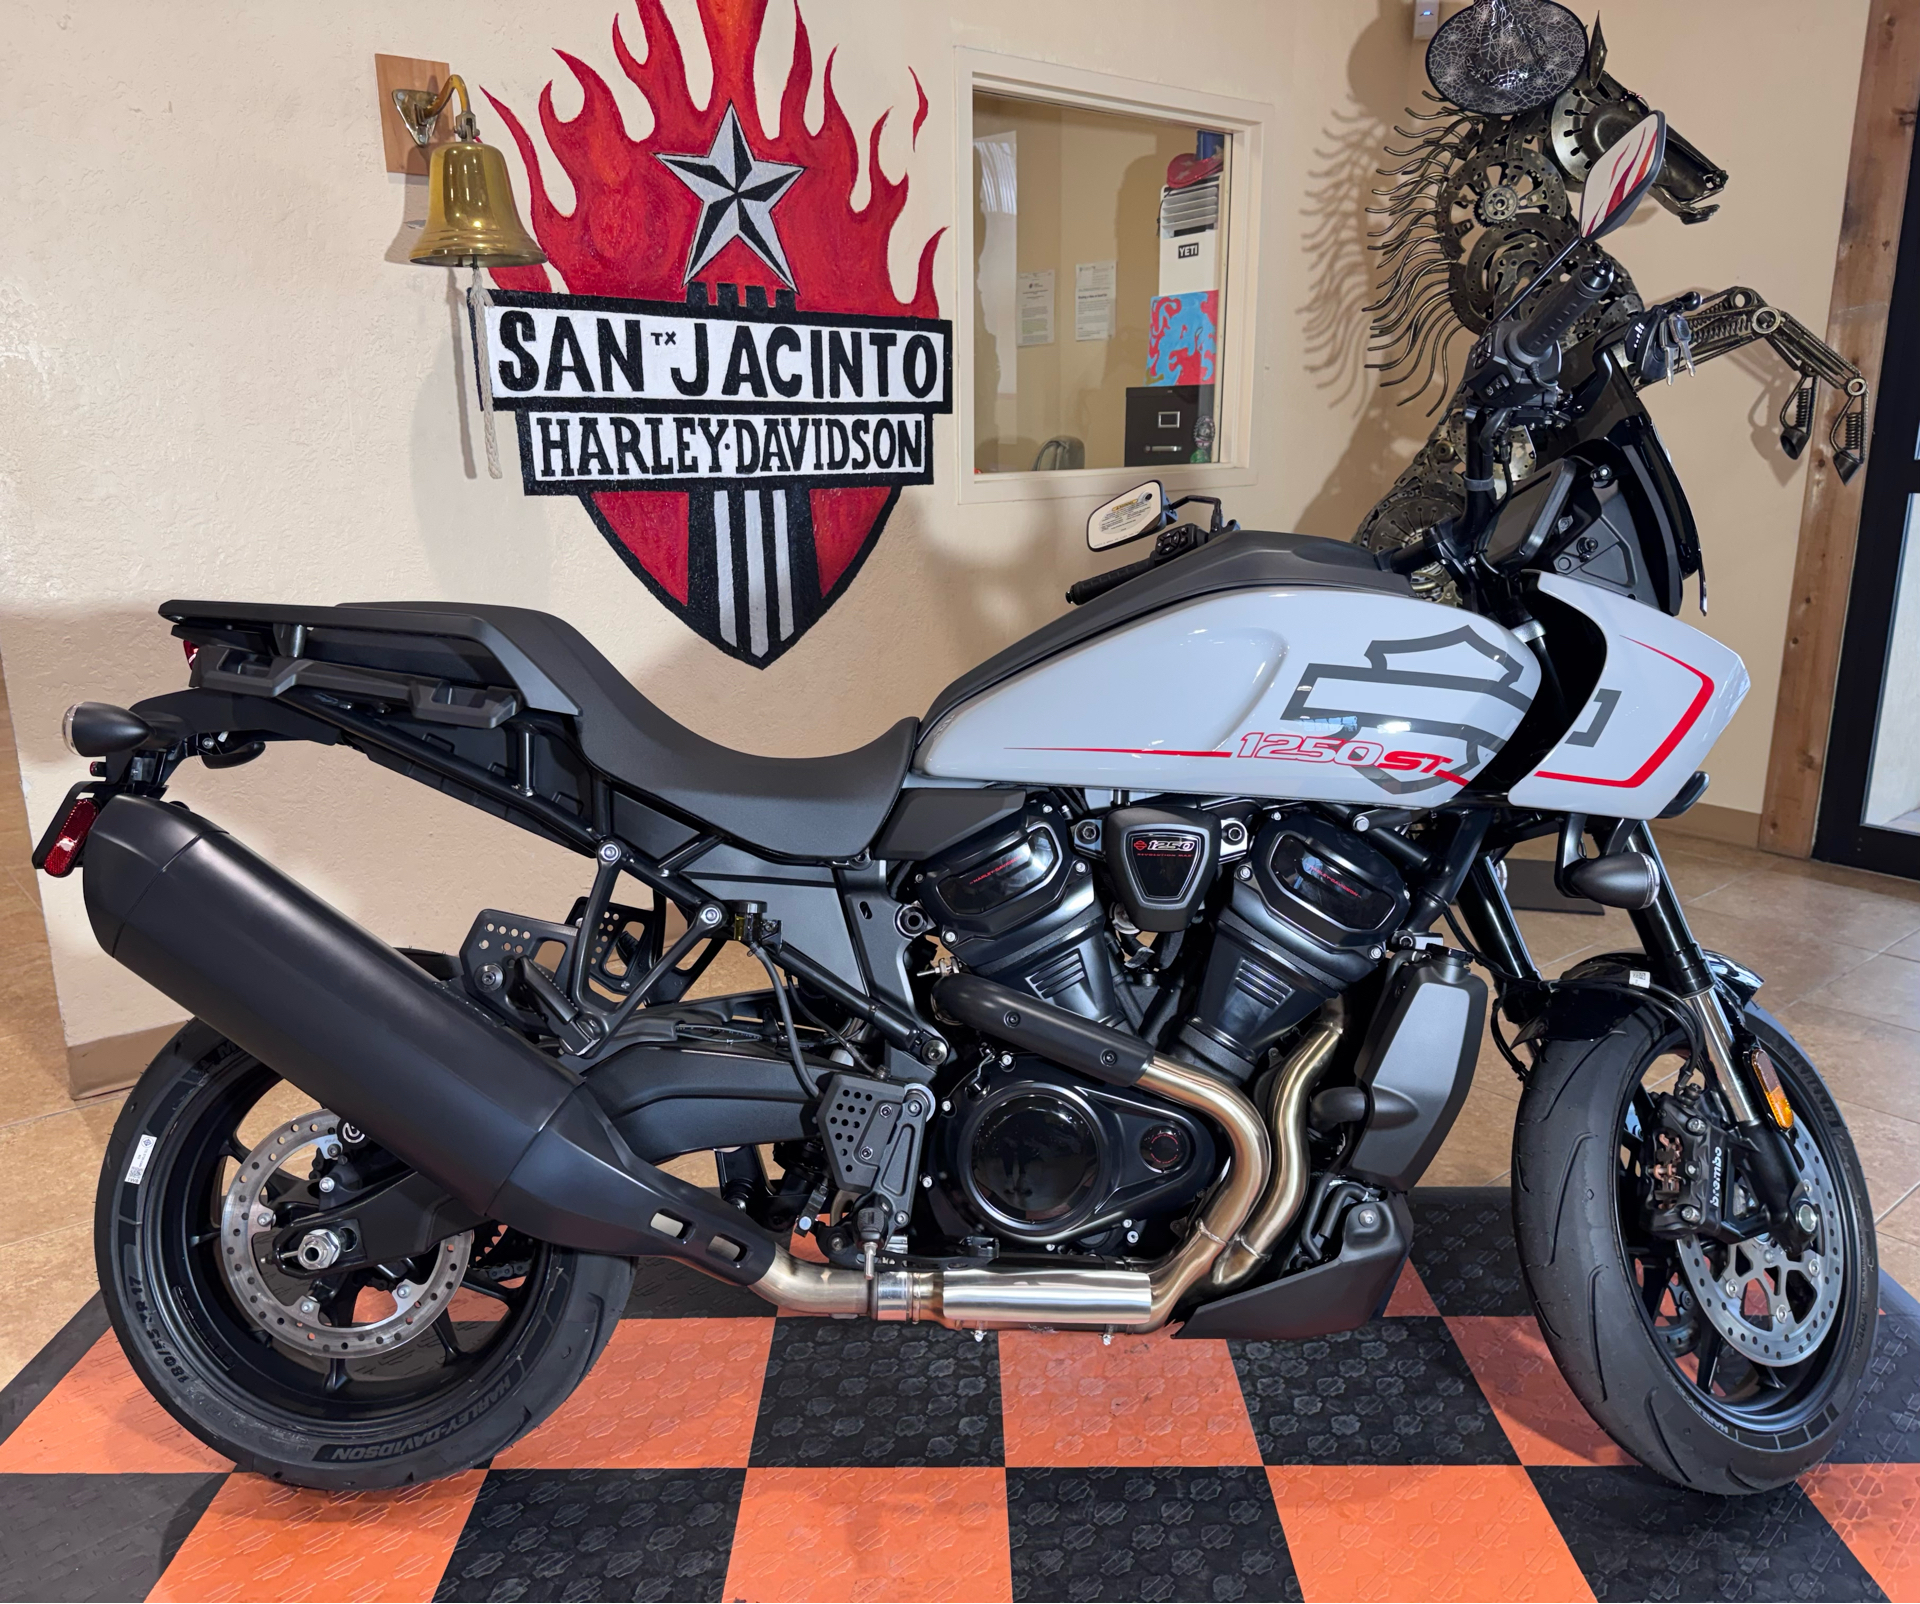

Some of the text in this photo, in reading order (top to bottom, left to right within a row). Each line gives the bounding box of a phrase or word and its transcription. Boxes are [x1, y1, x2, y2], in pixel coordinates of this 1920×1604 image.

[1179, 245, 1198, 257] YETI
[499, 310, 938, 399] SAN TX JACINTO
[1147, 840, 1195, 851] 1250
[1710, 1146, 1722, 1207] brembo
[128, 1275, 142, 1295] 17
[331, 1374, 512, 1462] HARLEY-DAVIDSON
